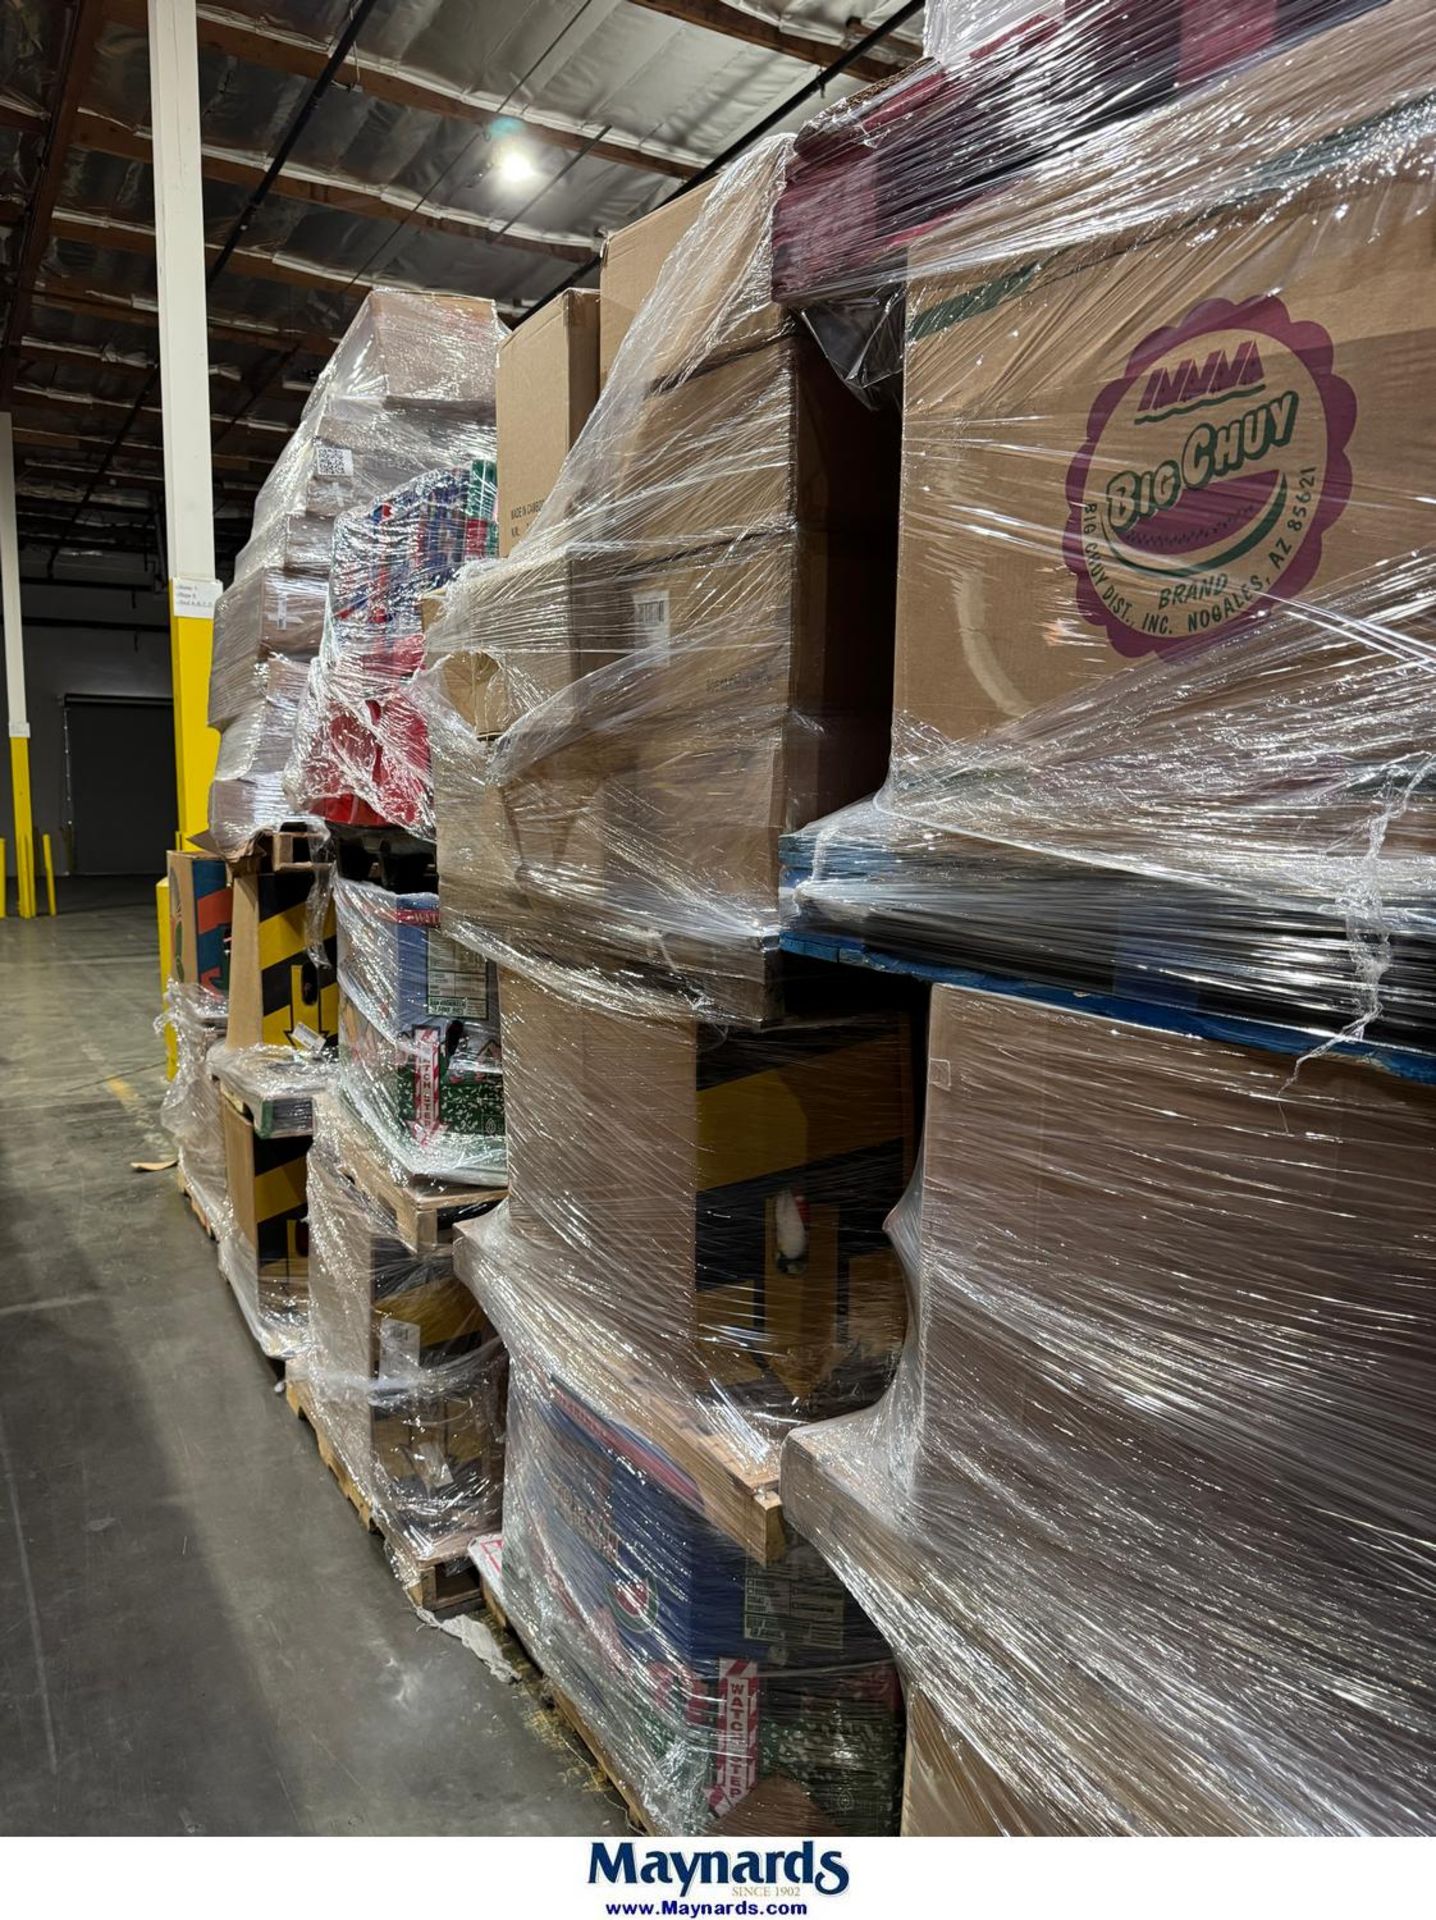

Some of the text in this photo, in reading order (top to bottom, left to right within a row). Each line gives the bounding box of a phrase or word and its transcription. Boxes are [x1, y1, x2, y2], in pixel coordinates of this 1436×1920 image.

[1106, 390, 1299, 531] BIG CHUY
[1287, 466, 1318, 532] 85621
[1083, 502, 1098, 534] BIG
[1084, 541, 1108, 588] CHUY
[1267, 540, 1293, 570] AZ
[1158, 573, 1228, 610] BRAND
[1142, 612, 1174, 634] INC.
